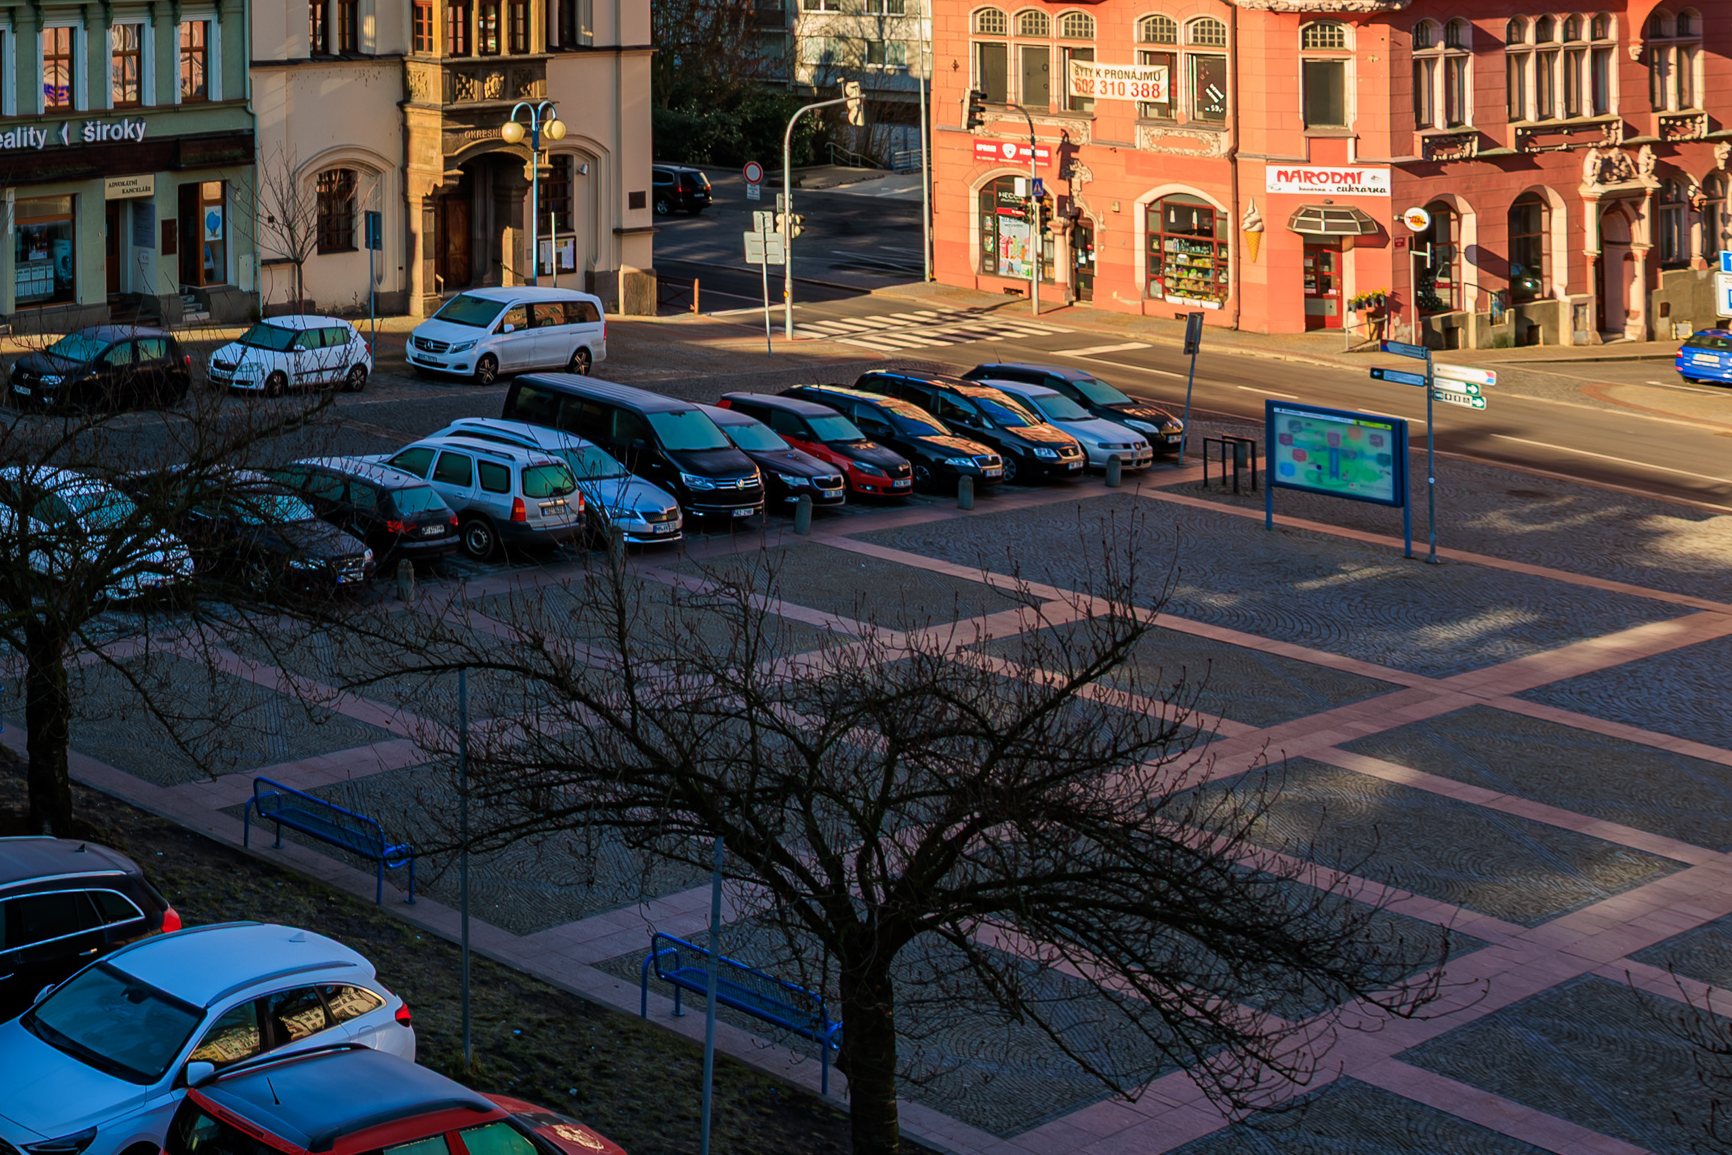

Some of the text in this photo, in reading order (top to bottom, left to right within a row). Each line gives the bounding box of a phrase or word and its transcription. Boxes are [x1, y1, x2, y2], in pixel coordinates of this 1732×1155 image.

[1075, 66, 1161, 82] BYTY K PRONÁJMU
[1075, 78, 1161, 99] 602 310 388
[83, 118, 147, 143] široký
[108, 179, 137, 188] ADVOKÁTNÍ
